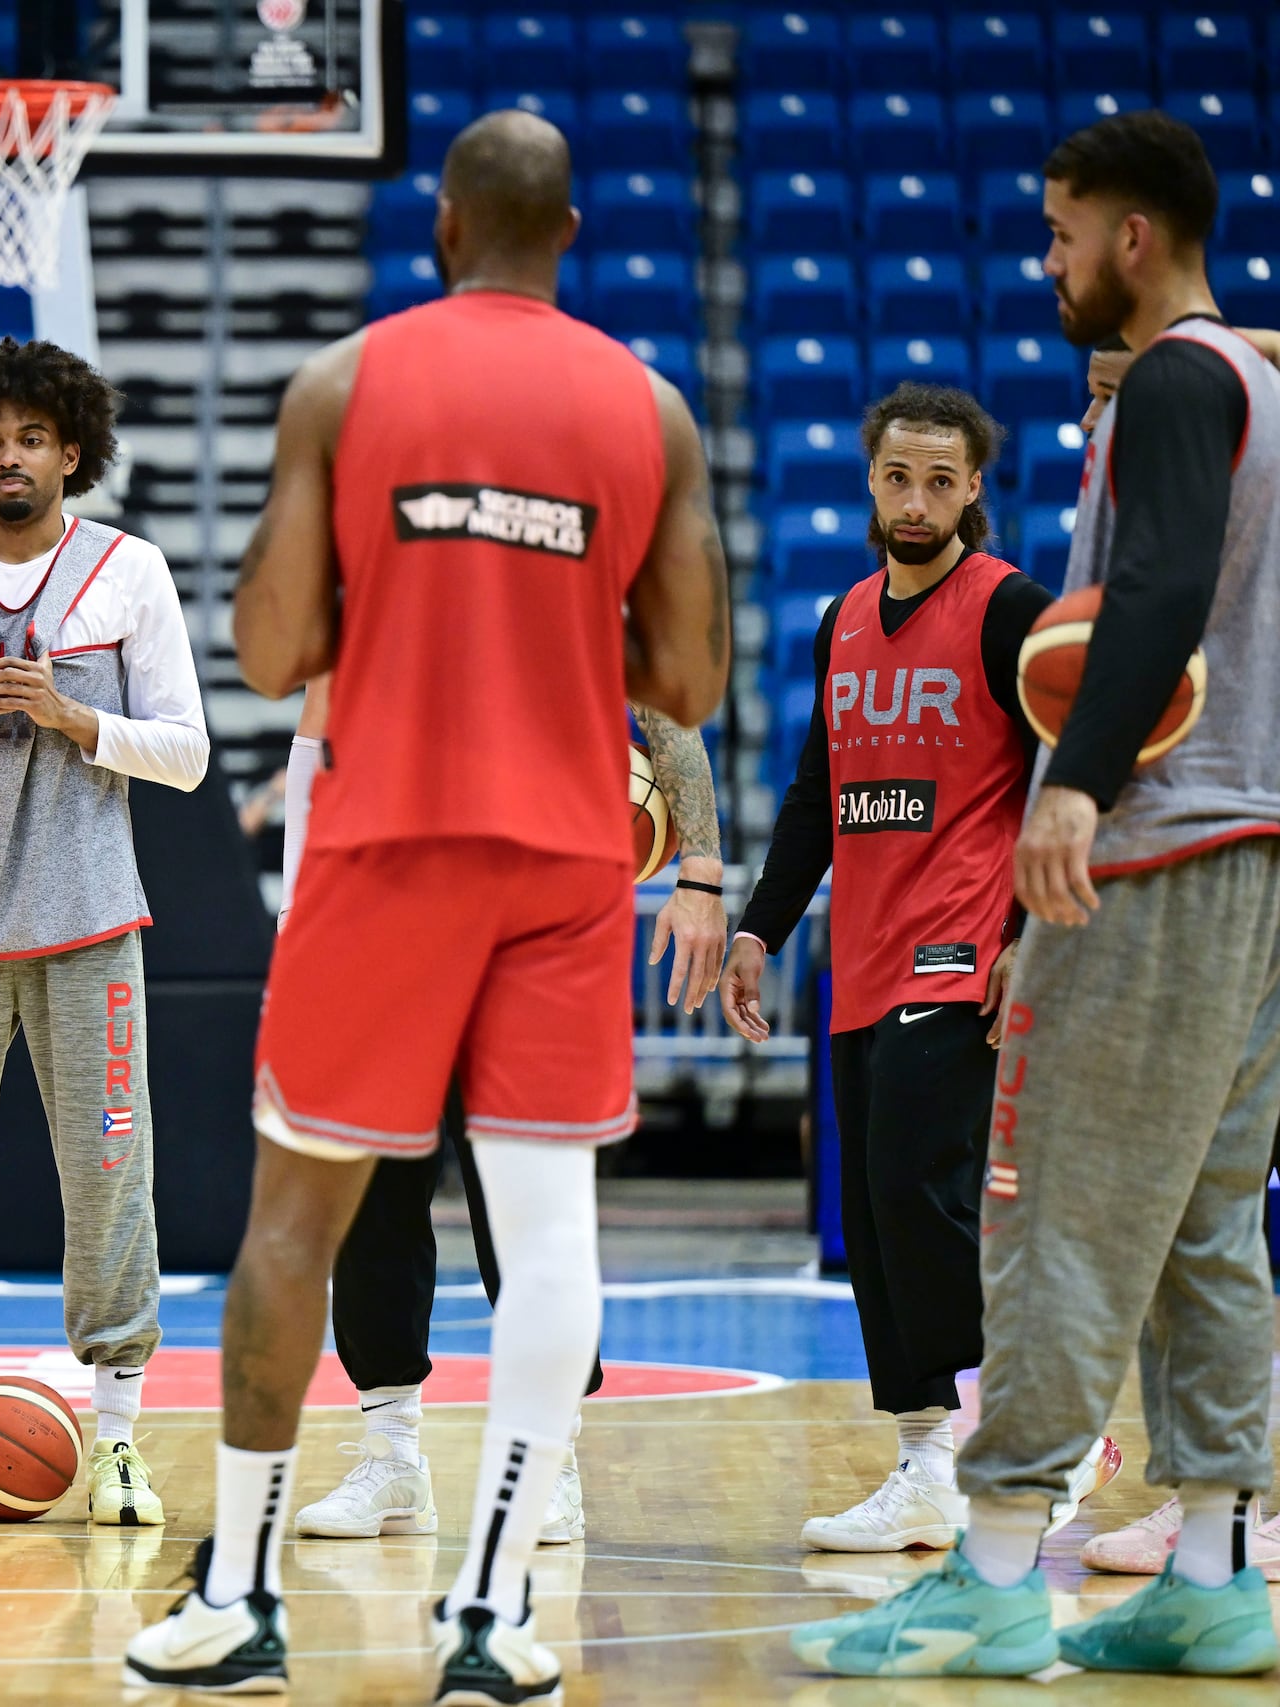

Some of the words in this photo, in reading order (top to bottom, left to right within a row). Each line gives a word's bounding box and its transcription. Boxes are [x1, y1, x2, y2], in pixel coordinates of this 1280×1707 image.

[832, 668, 961, 730] PUR
[831, 735, 964, 751] BSKETBALL
[105, 982, 132, 1095] PUR
[991, 1002, 1035, 1147] PUR
